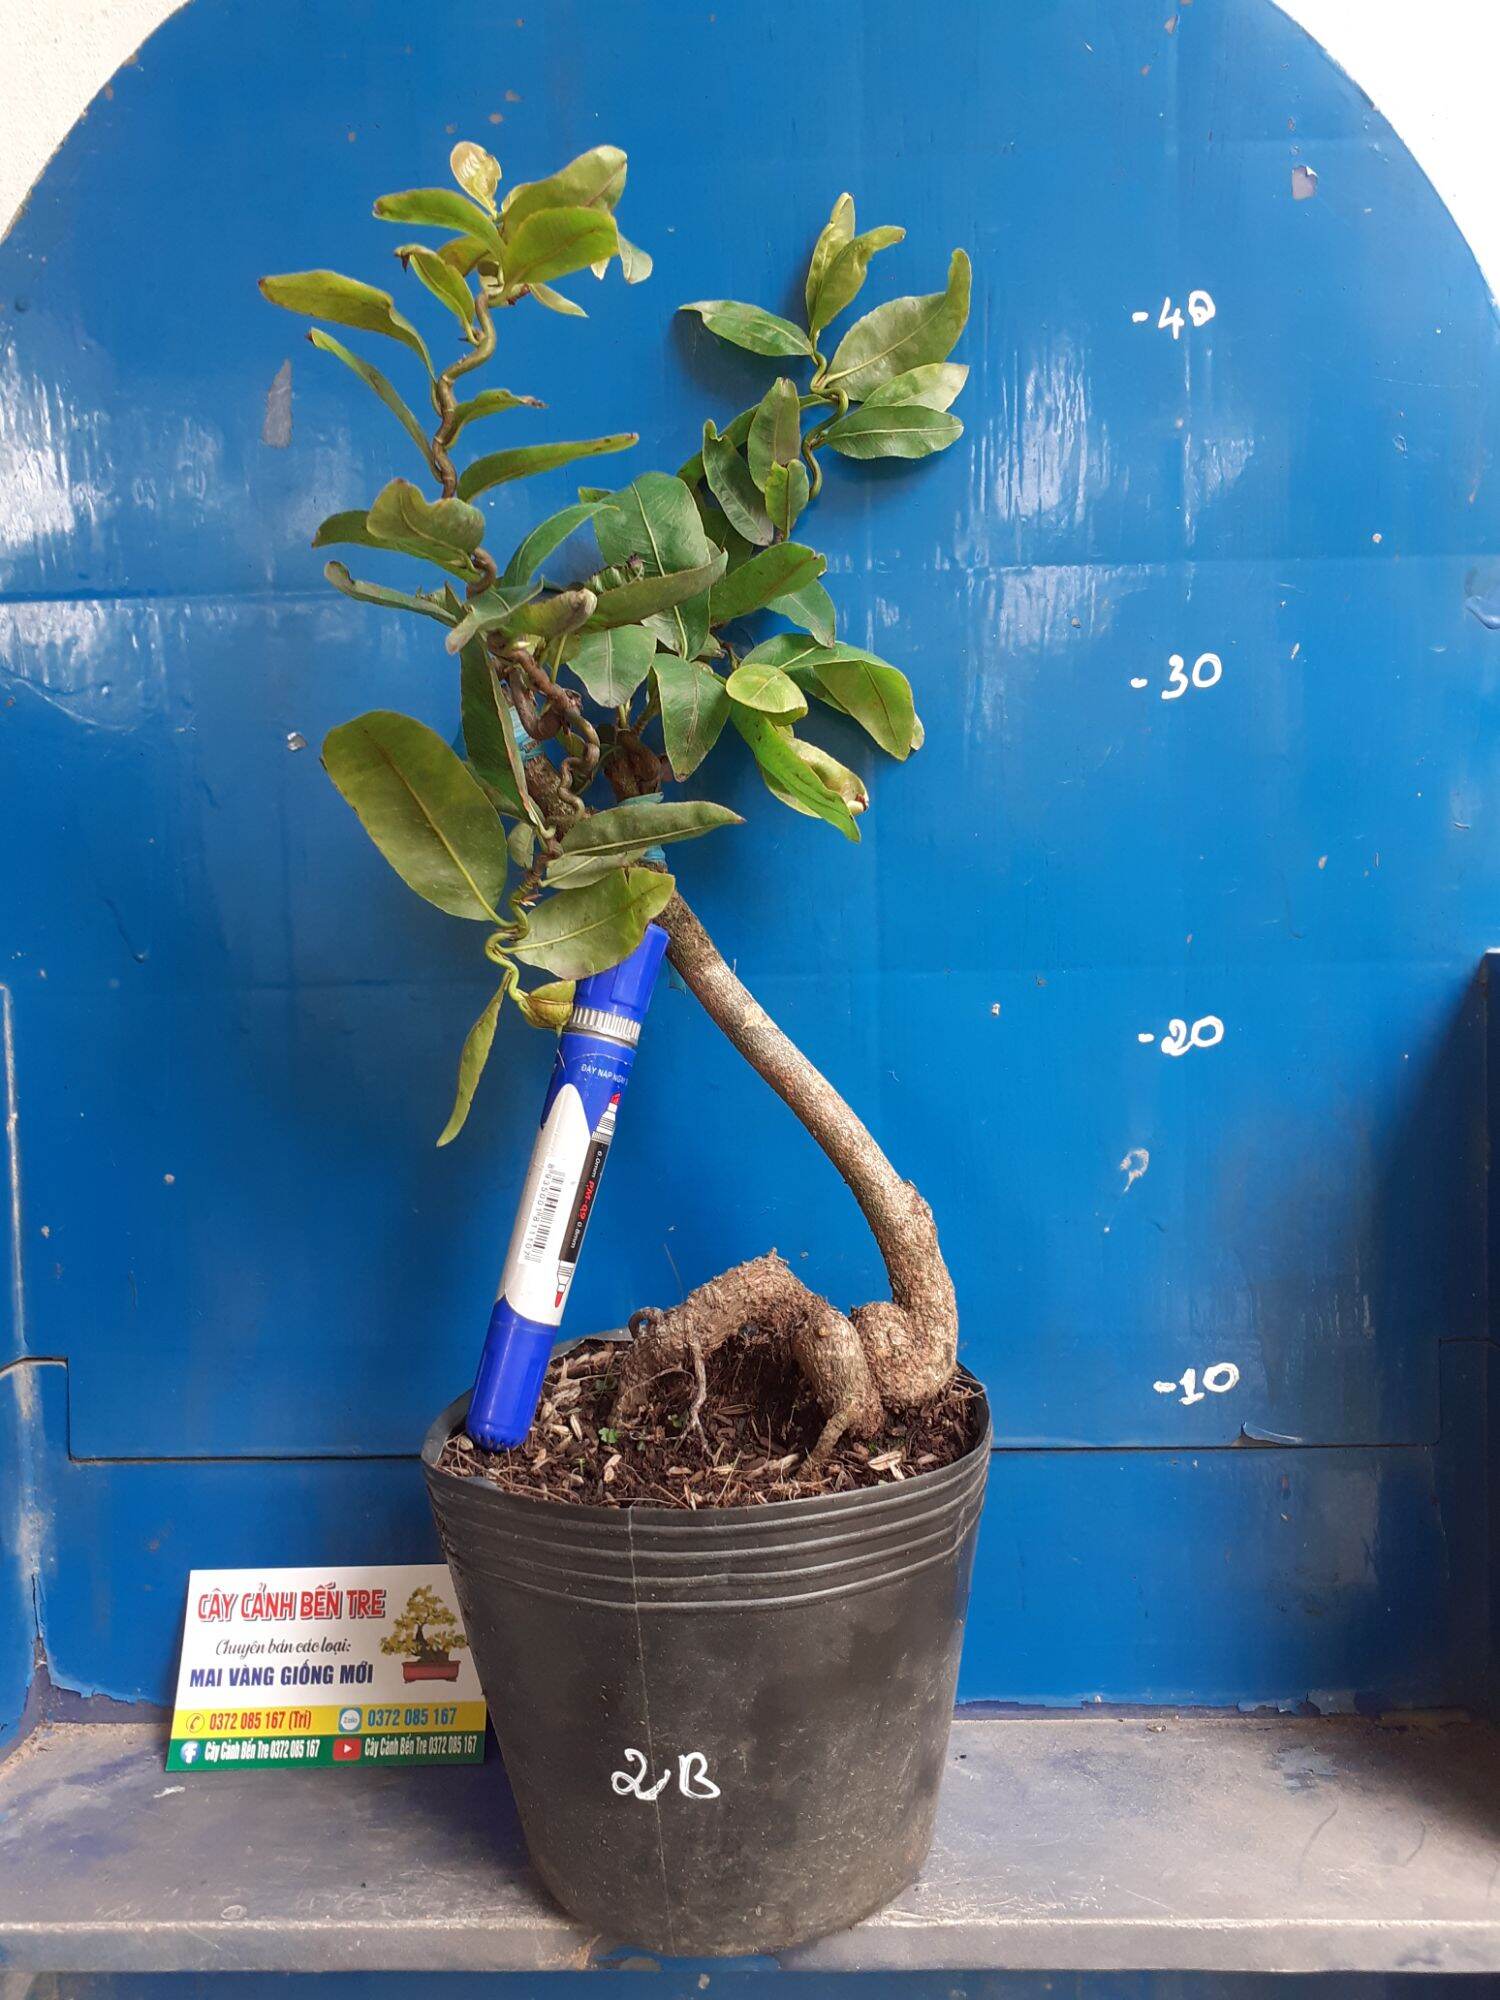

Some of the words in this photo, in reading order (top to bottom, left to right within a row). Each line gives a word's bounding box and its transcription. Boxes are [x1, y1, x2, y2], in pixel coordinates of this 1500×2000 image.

[198, 1587, 237, 1622] CÂY
[240, 1582, 297, 1622] CẢNH
[299, 1581, 343, 1620] BẾN
[346, 1589, 387, 1619] TRE
[189, 1668, 223, 1687] MAI
[229, 1664, 274, 1686] VÀNG
[280, 1658, 334, 1685] GIỐNG
[339, 1660, 374, 1684] MỚI
[209, 1712, 238, 1730] 0372
[240, 1711, 262, 1729] 085
[265, 1710, 286, 1728] 167
[367, 1708, 401, 1727] 0372
[404, 1708, 429, 1726] 085
[434, 1707, 457, 1725] 167
[306, 1739, 321, 1758] 167
[463, 1735, 478, 1753] 167
